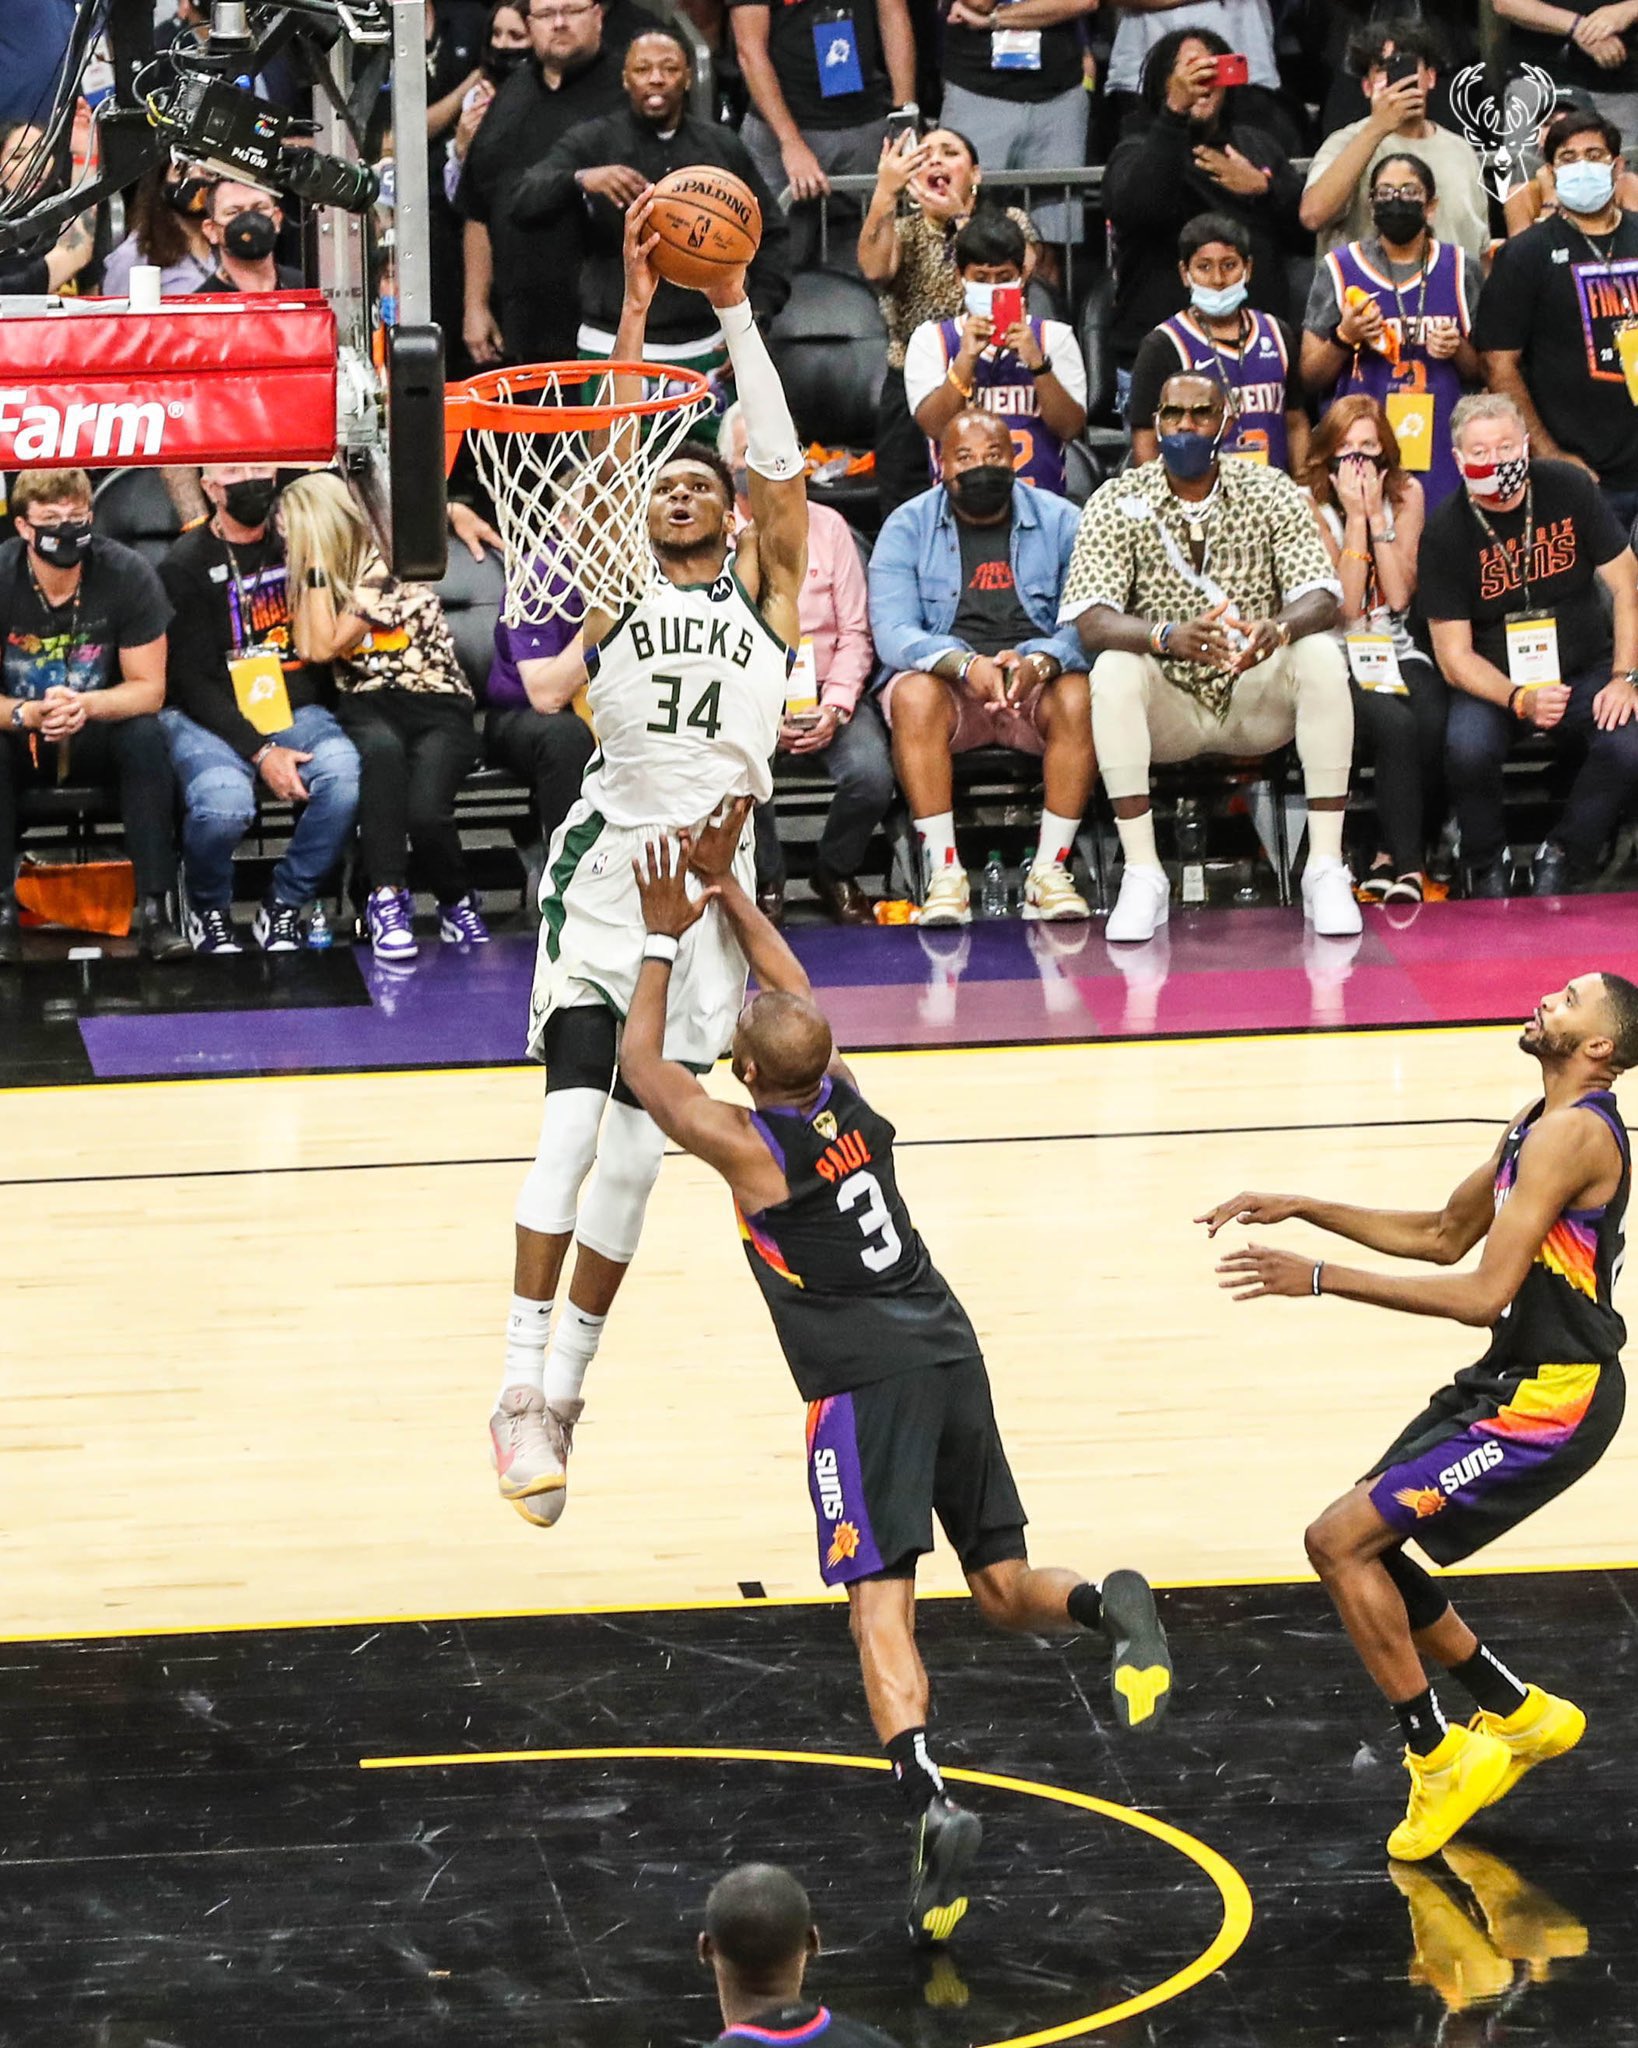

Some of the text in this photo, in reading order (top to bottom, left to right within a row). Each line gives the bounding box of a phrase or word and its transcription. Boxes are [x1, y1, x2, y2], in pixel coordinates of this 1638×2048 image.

[671, 178, 752, 226] SPALDING
[629, 616, 754, 670] BUCKS
[646, 673, 722, 740] 34
[815, 1129, 873, 1184] PAUL
[836, 1168, 903, 1274] 3
[814, 1448, 845, 1521] SUNS
[1438, 1439, 1505, 1496] SUNS
